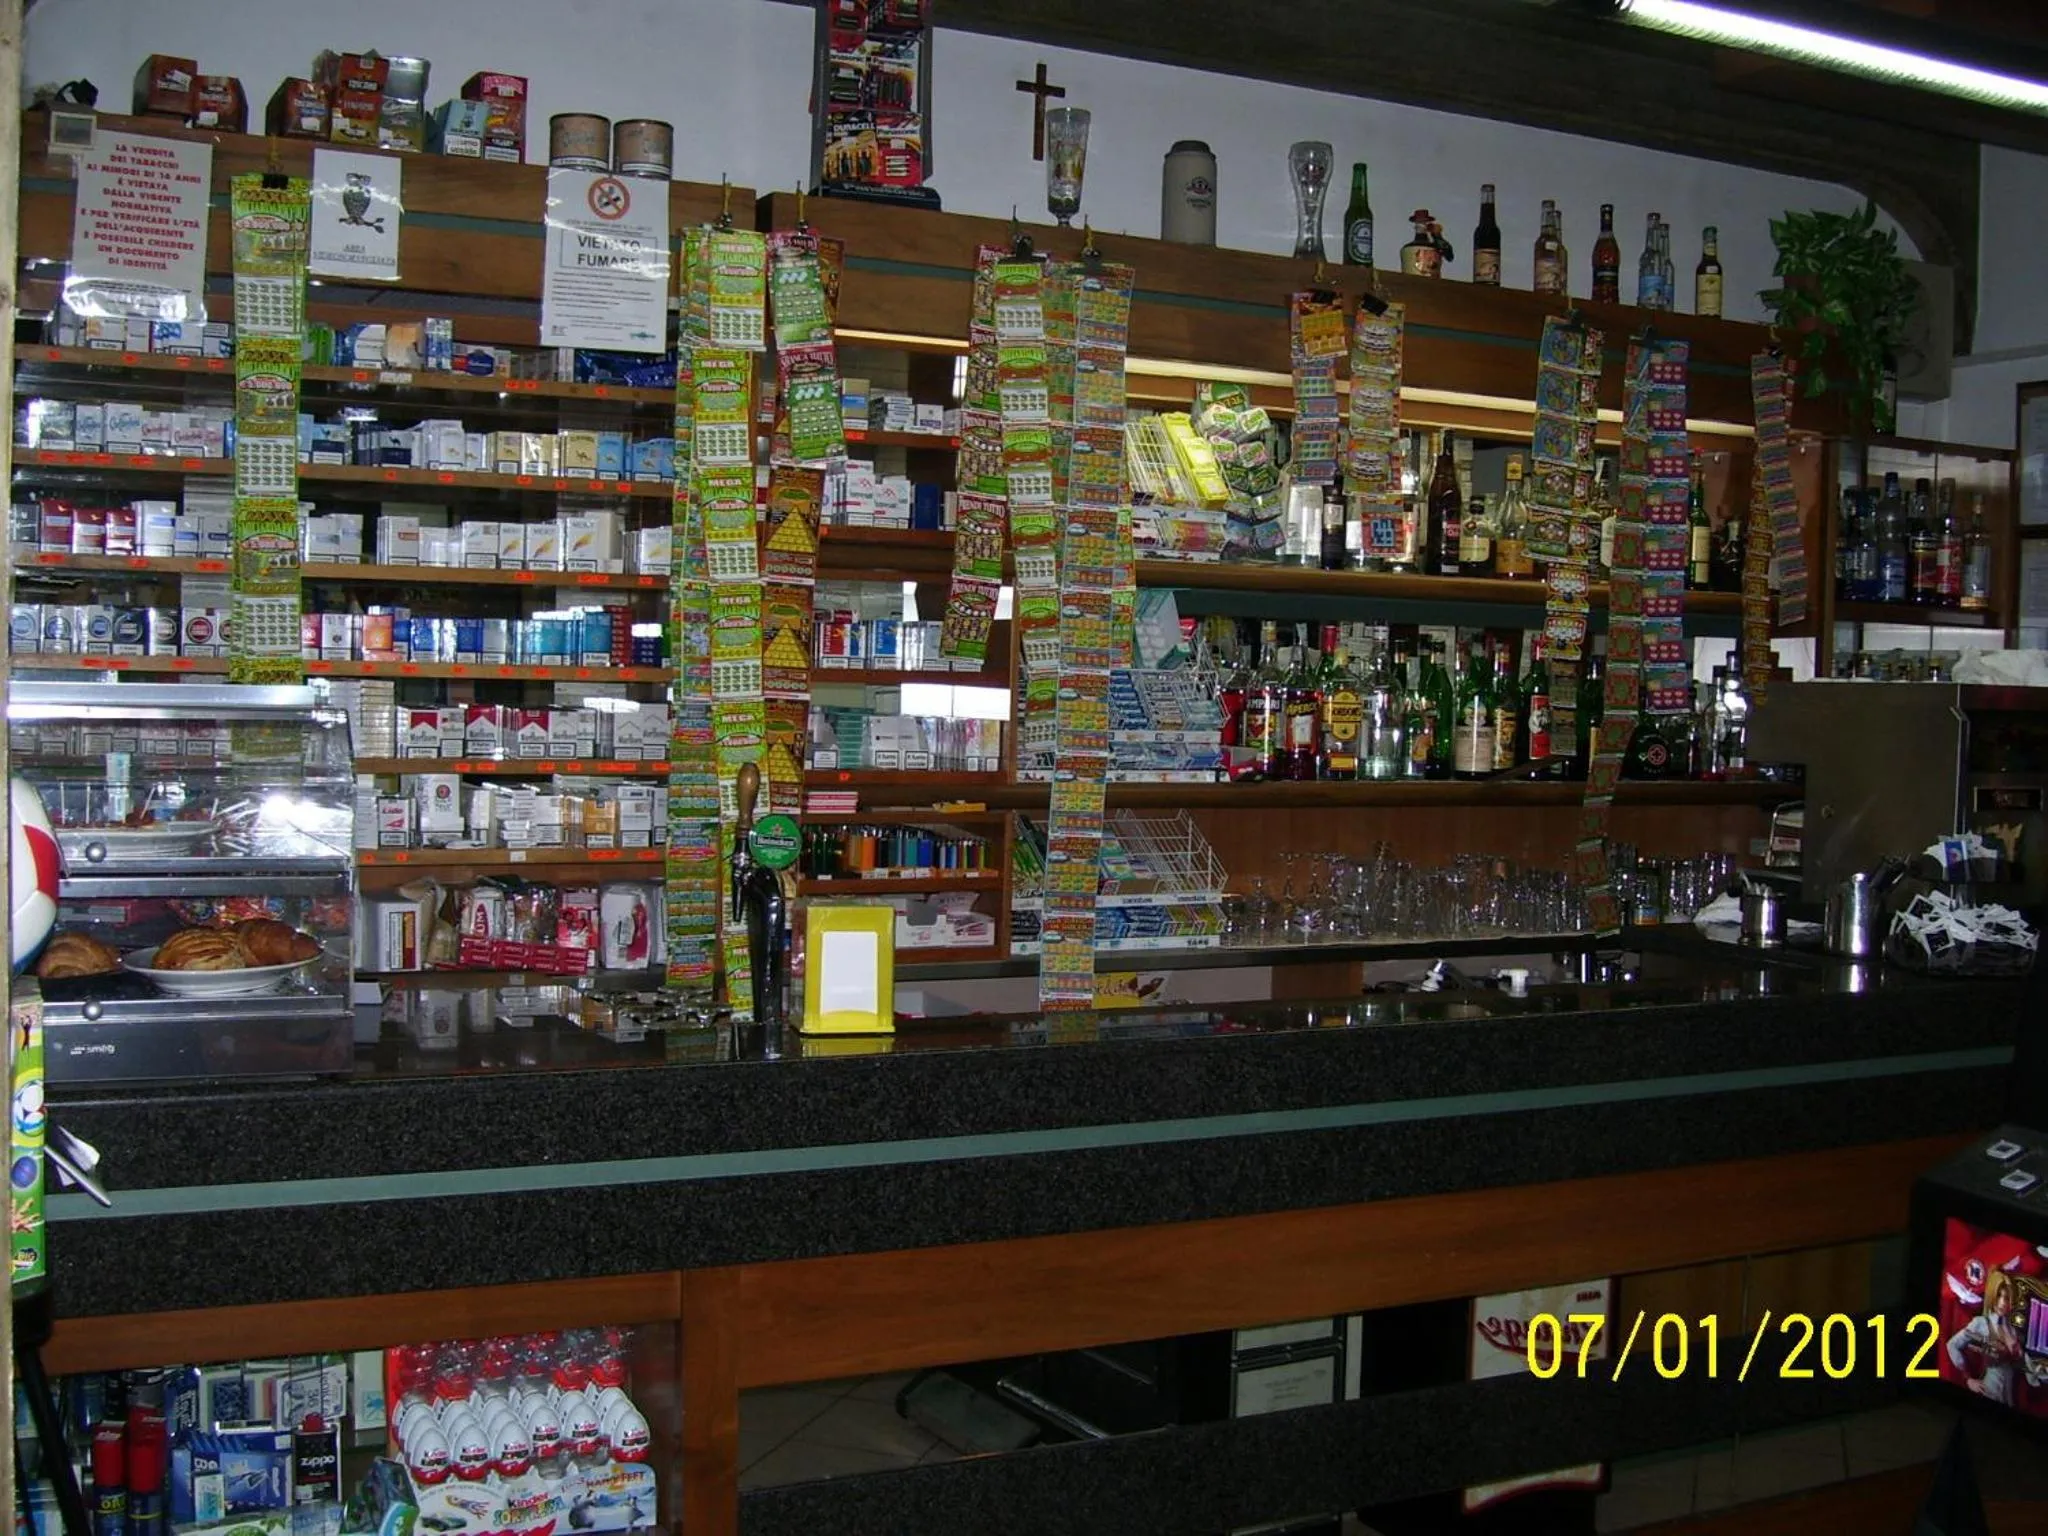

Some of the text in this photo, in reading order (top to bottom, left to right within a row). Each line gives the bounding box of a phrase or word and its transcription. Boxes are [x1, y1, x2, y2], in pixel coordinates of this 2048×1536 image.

[833, 122, 876, 132] DURACELL
[132, 146, 175, 158] VENDITA
[110, 154, 179, 170] DEI TABACCHI
[86, 163, 98, 171] AI
[101, 164, 140, 176] MINORI
[143, 170, 155, 178] DI
[175, 175, 201, 184] ANNI
[128, 179, 168, 191] VIETATA
[103, 187, 182, 204] DALLA VIGENTE
[111, 200, 172, 214] NORMATIVA
[90, 209, 109, 219] PER
[113, 212, 169, 225] VERIFICARE
[95, 221, 185, 238] DELL'ACQUIRENTE
[93, 232, 145, 246] POSSIBILE
[147, 238, 194, 250] CHIEDERE
[577, 235, 641, 251] VIETTO
[97, 244, 180, 260] UN DOCUMENTO
[108, 257, 119, 265] DI
[709, 478, 741, 487] MEGA
[300, 1455, 336, 1467] zippo
[622, 1471, 645, 1483] FEET
[508, 1491, 550, 1508] Kinder
